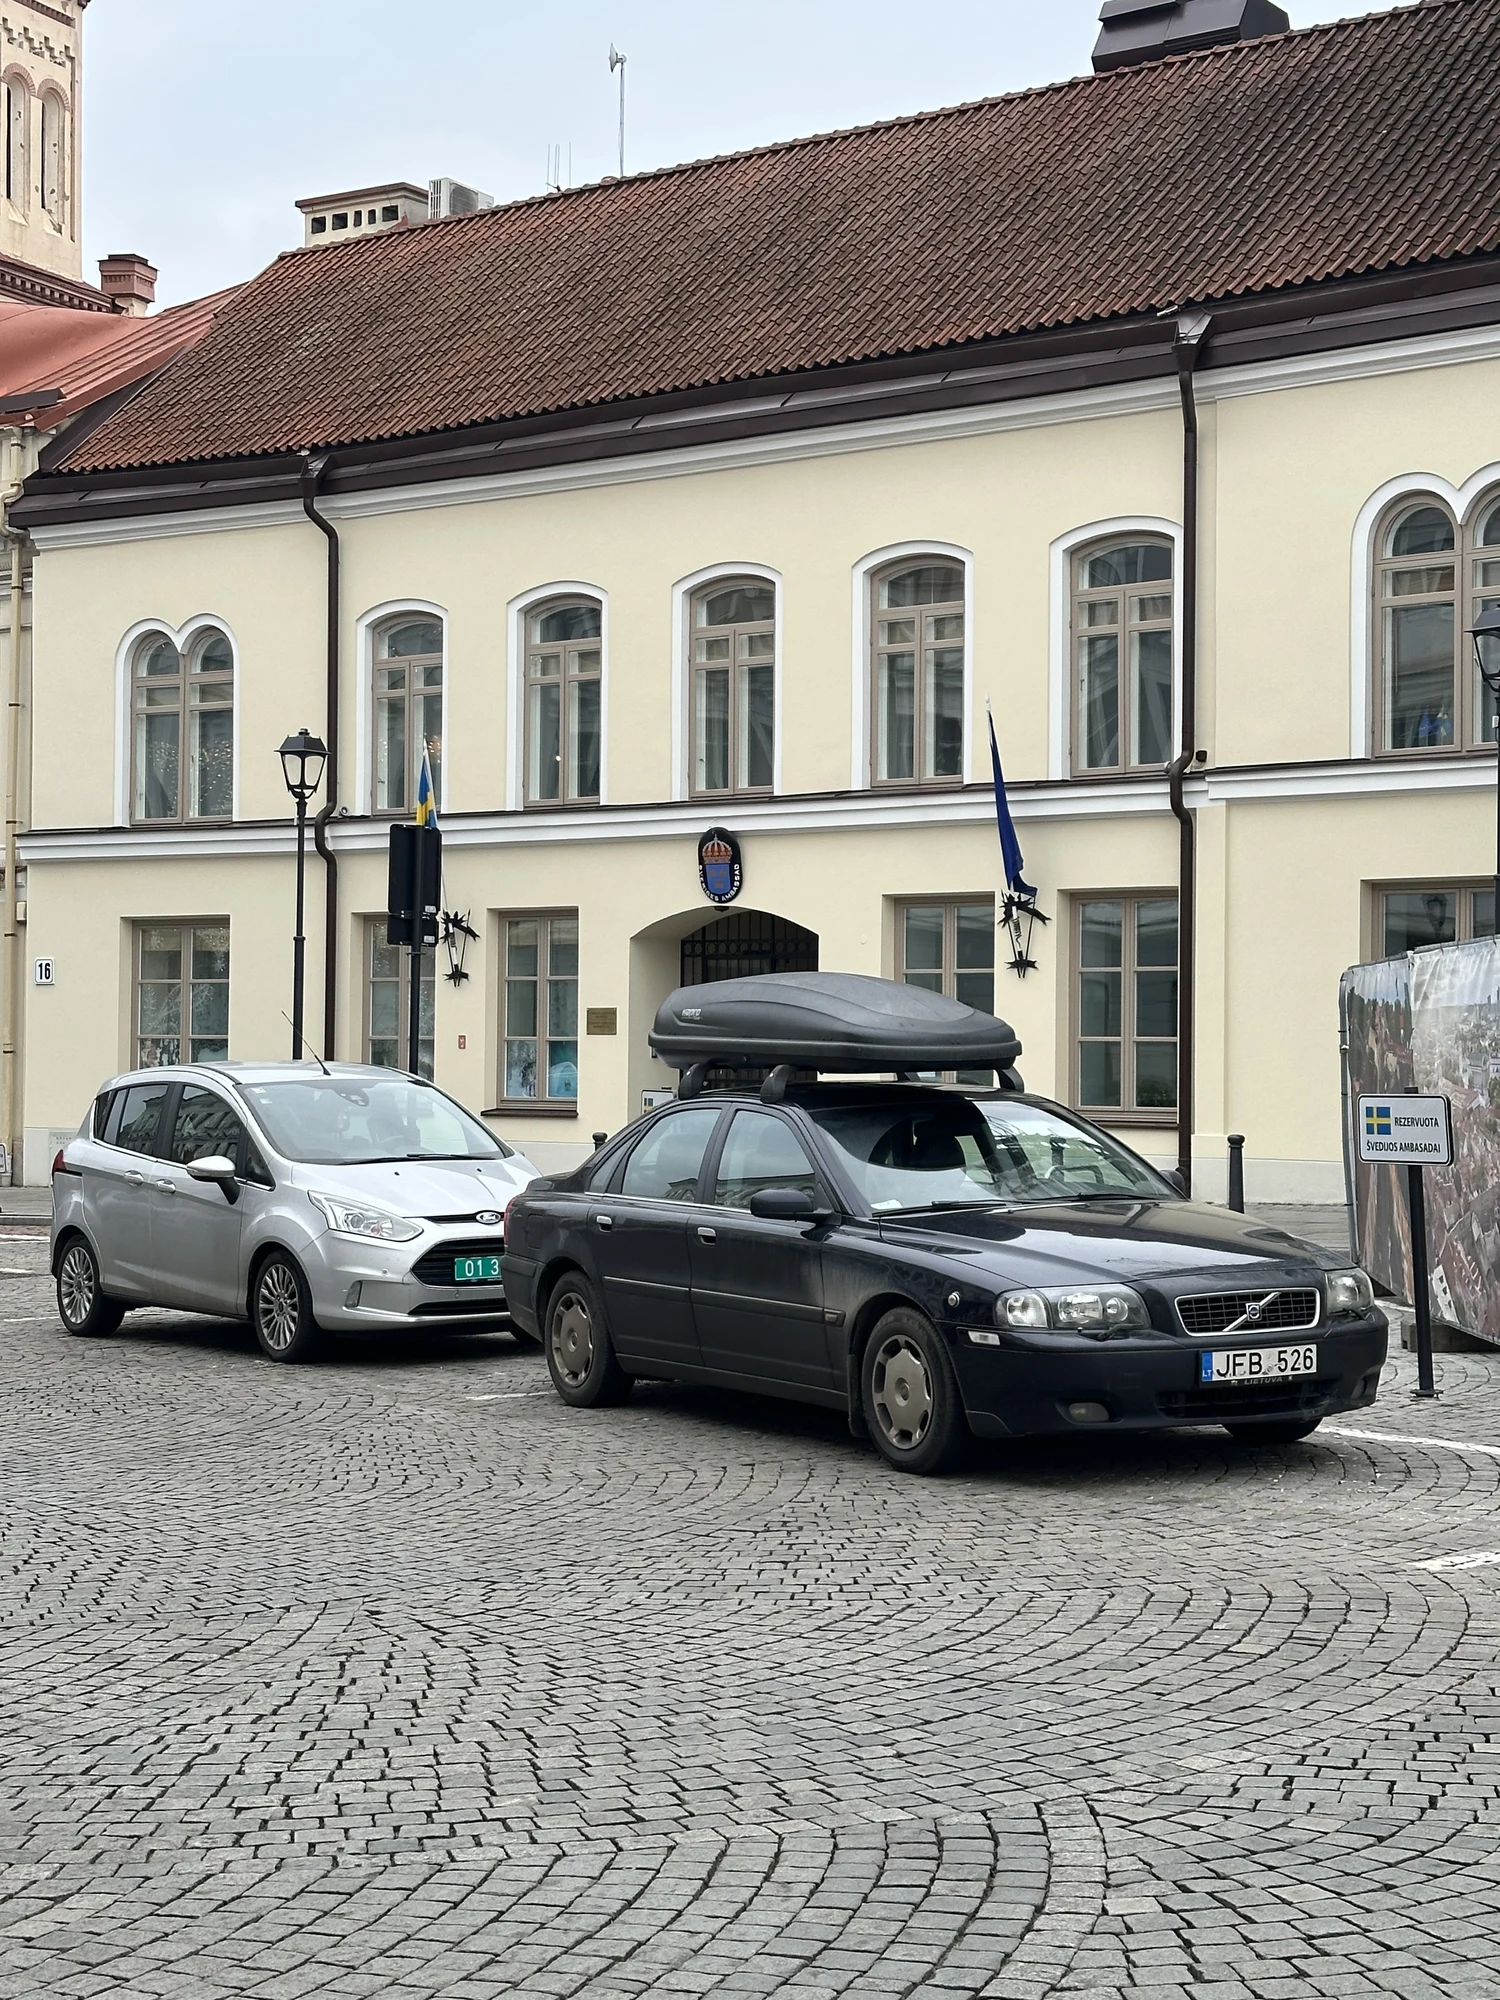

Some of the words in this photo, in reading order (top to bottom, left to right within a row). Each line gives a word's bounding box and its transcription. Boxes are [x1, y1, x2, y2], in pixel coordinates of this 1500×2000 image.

[721, 863, 741, 902] AMBASSAD
[38, 962, 51, 980] 16
[1394, 1116, 1440, 1128] REZERVUOTA
[1366, 1139, 1399, 1152] ŠVEDIJOS
[1399, 1142, 1441, 1154] AMBASADAI
[465, 1259, 483, 1277] 01
[490, 1258, 500, 1276] 3
[1202, 1369, 1213, 1378] LT
[1216, 1352, 1263, 1377] JFB
[1277, 1347, 1314, 1373] 526
[1244, 1376, 1283, 1386] LIETUVA
